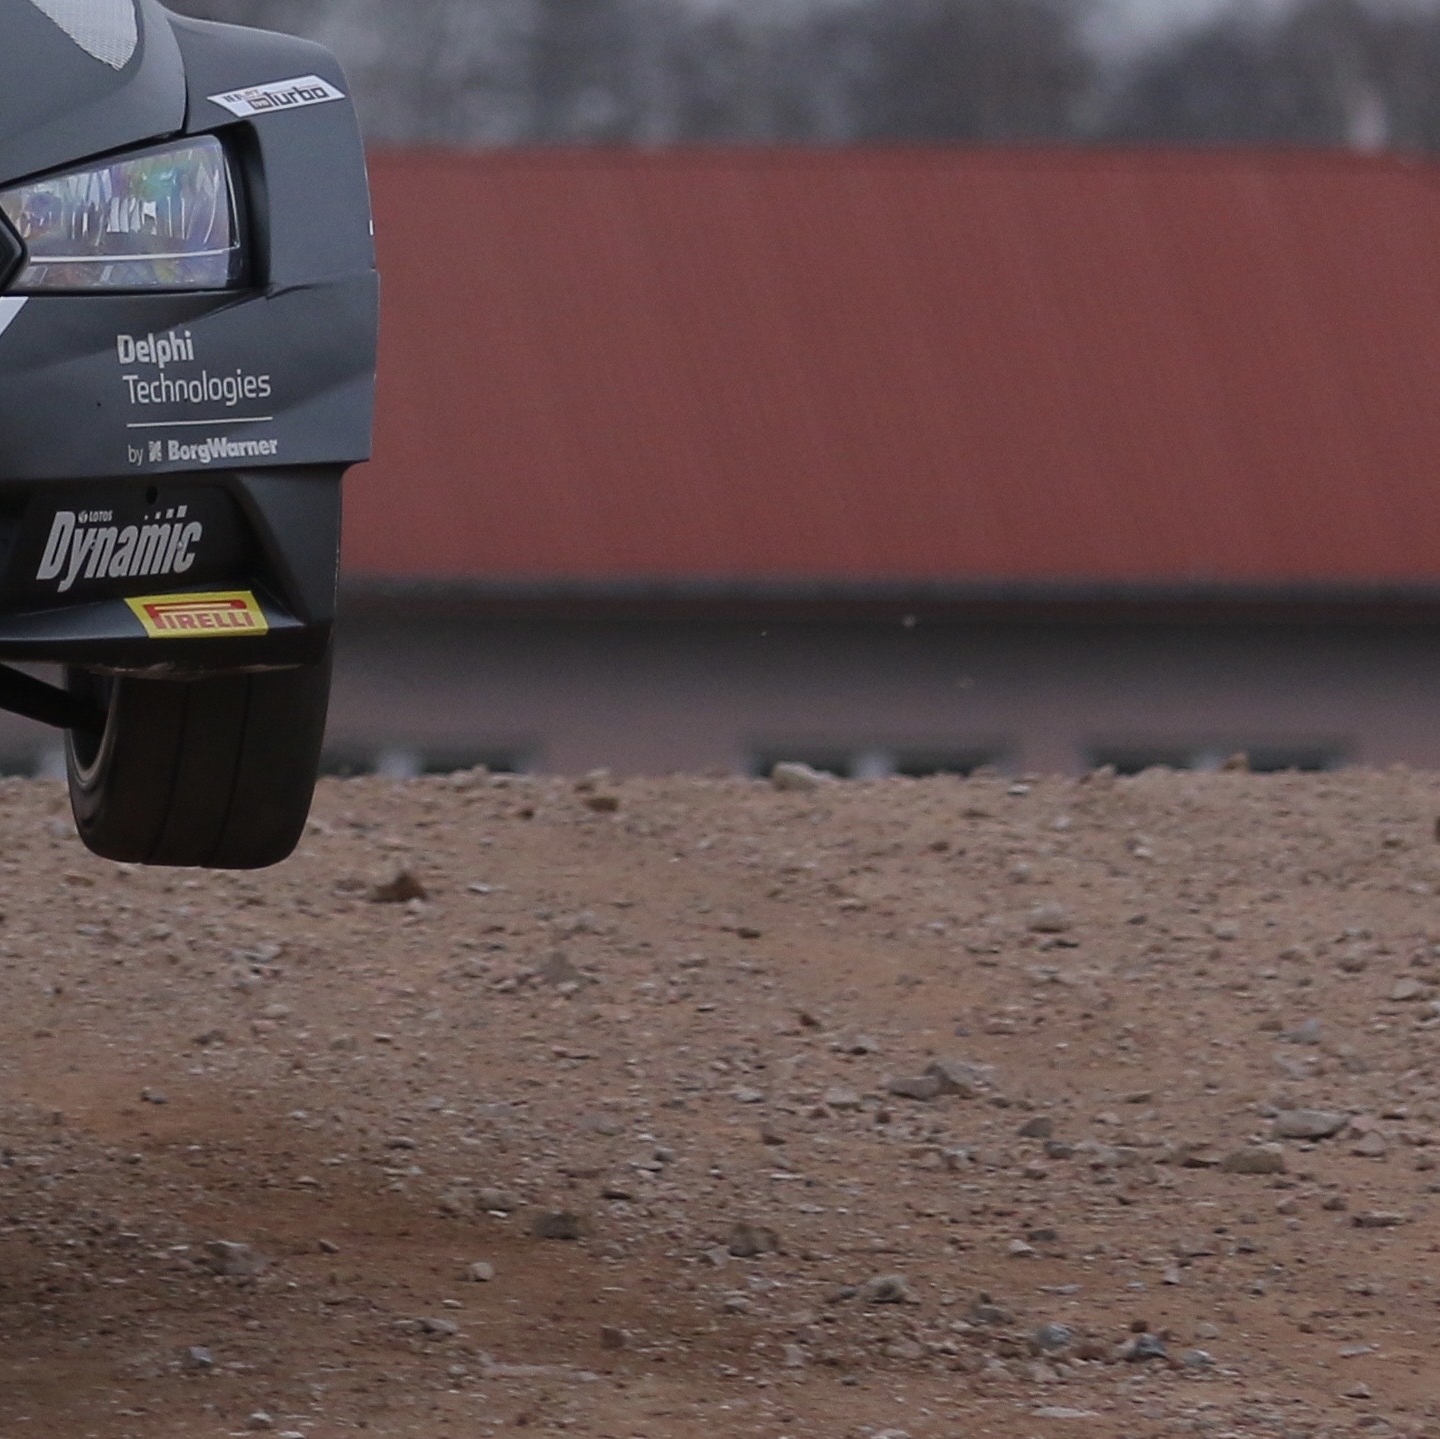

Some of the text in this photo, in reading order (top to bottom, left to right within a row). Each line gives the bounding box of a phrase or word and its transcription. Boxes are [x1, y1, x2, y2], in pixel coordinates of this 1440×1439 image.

[117, 330, 194, 369] Delphi
[122, 369, 271, 406] Technologies
[128, 437, 278, 466] by BorgWarner
[89, 510, 113, 522] LOTOS
[36, 505, 202, 592] Dynamic
[142, 599, 255, 630] PIRELLI
